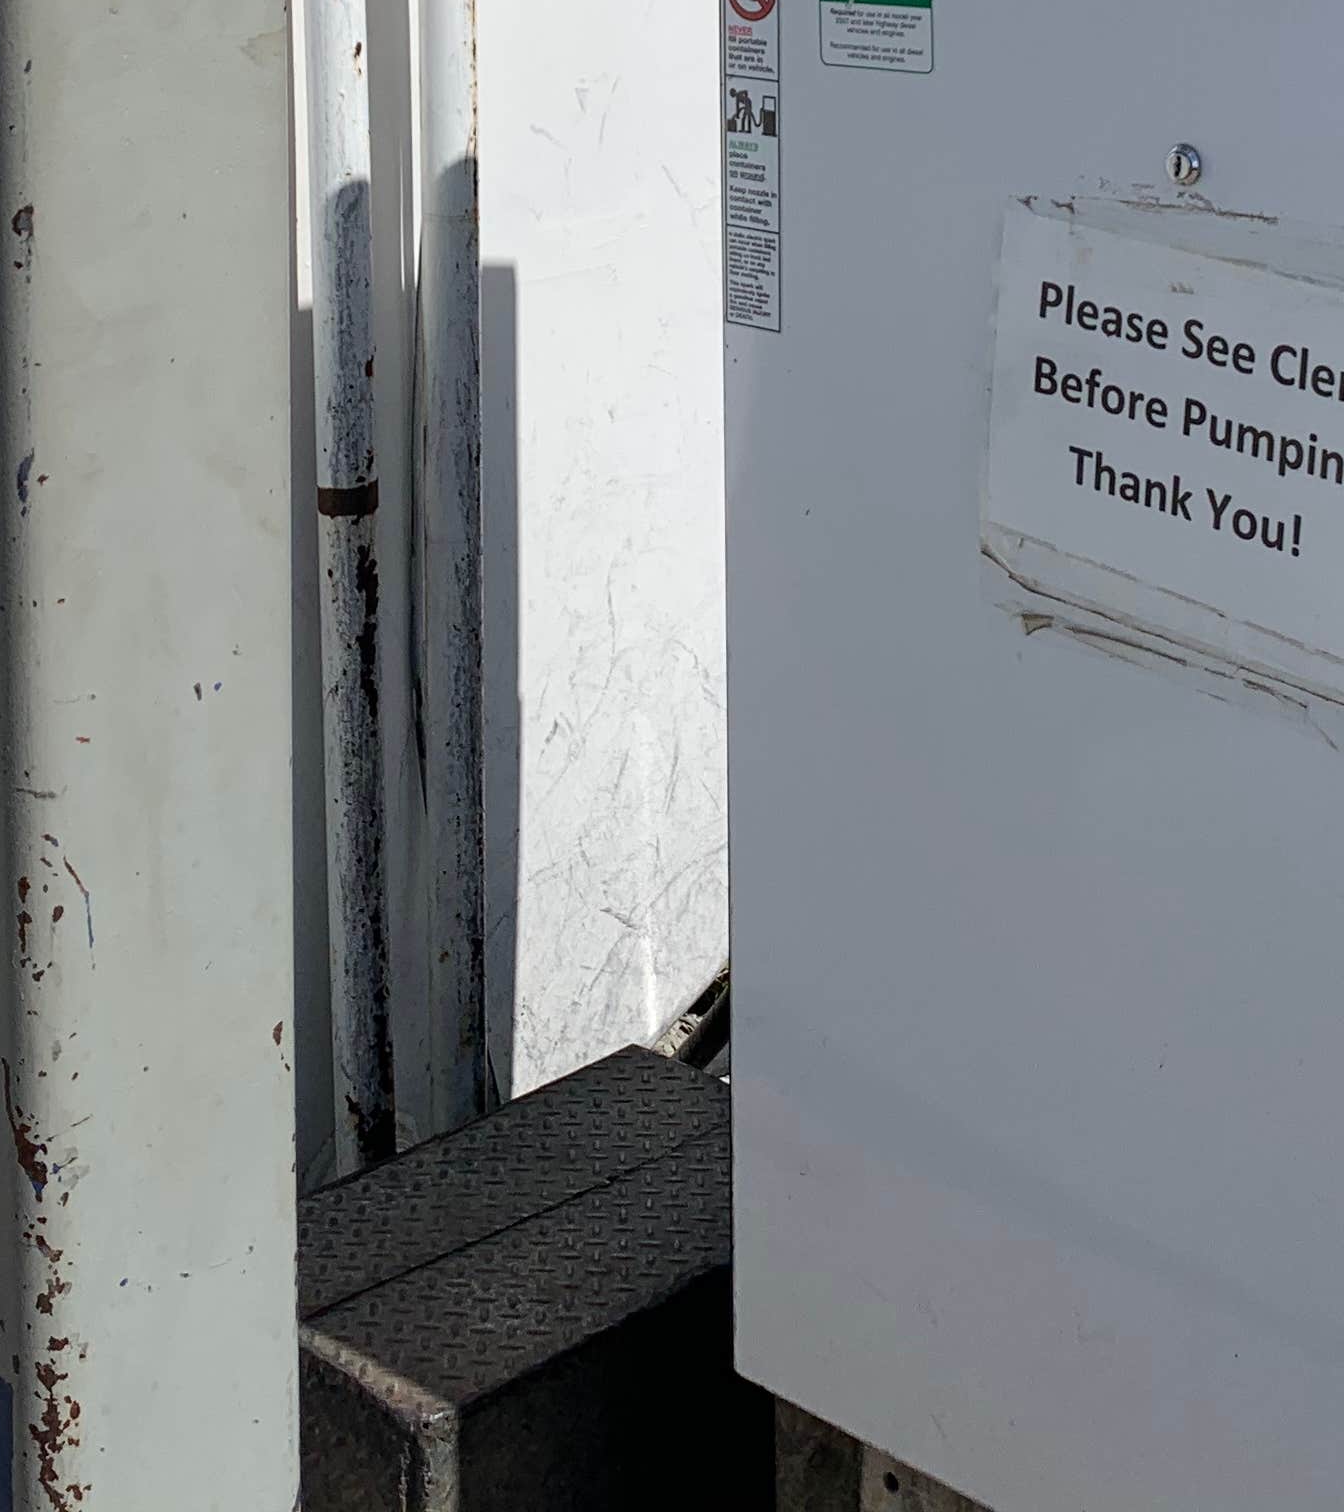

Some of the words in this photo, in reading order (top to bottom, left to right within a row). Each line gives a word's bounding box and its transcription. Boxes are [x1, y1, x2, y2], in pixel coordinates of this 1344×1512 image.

[1038, 279, 1169, 351] Please
[1181, 319, 1256, 375] See
[1033, 356, 1169, 428] Before
[1068, 446, 1193, 522] Thank
[1206, 489, 1302, 557] You!
